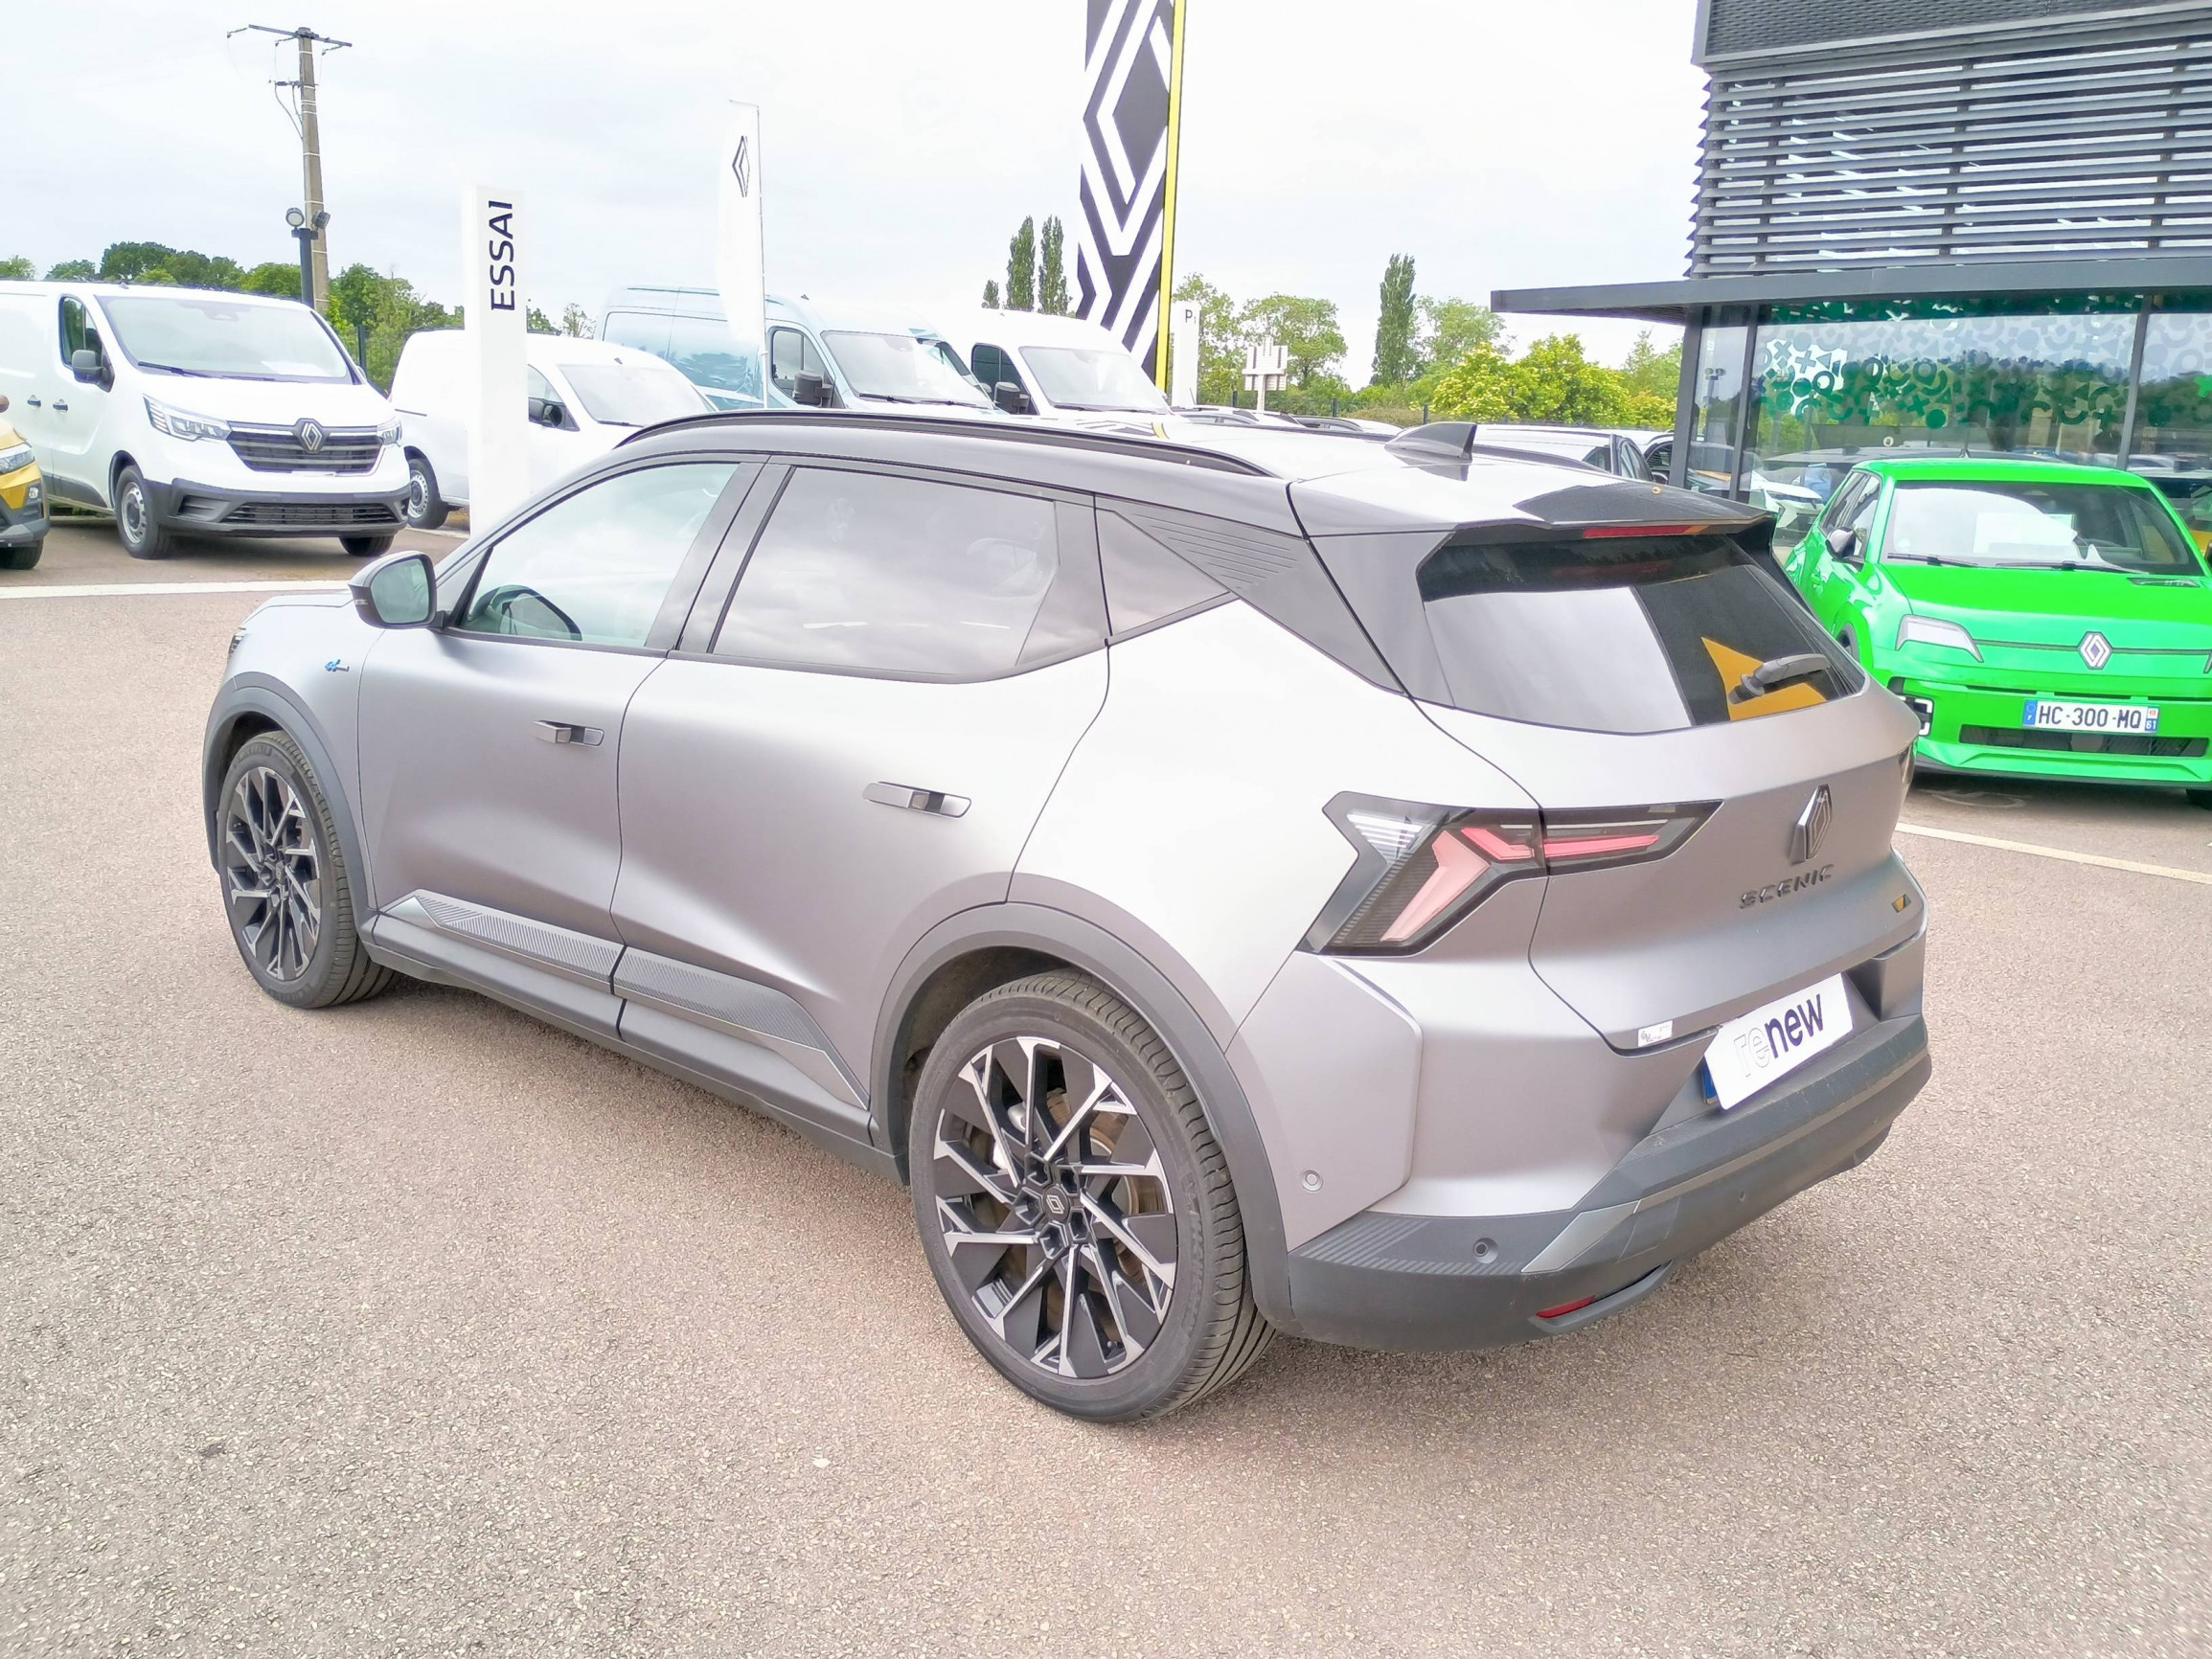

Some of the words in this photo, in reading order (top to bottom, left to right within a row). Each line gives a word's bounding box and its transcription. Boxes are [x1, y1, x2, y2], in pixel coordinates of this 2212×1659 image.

[489, 200, 515, 310] ESSAI
[2038, 705, 2142, 729] HC-300-MQ
[2145, 719, 2156, 729] 61
[1739, 864, 1834, 909] SCENIC
[1733, 993, 1824, 1078] renew
